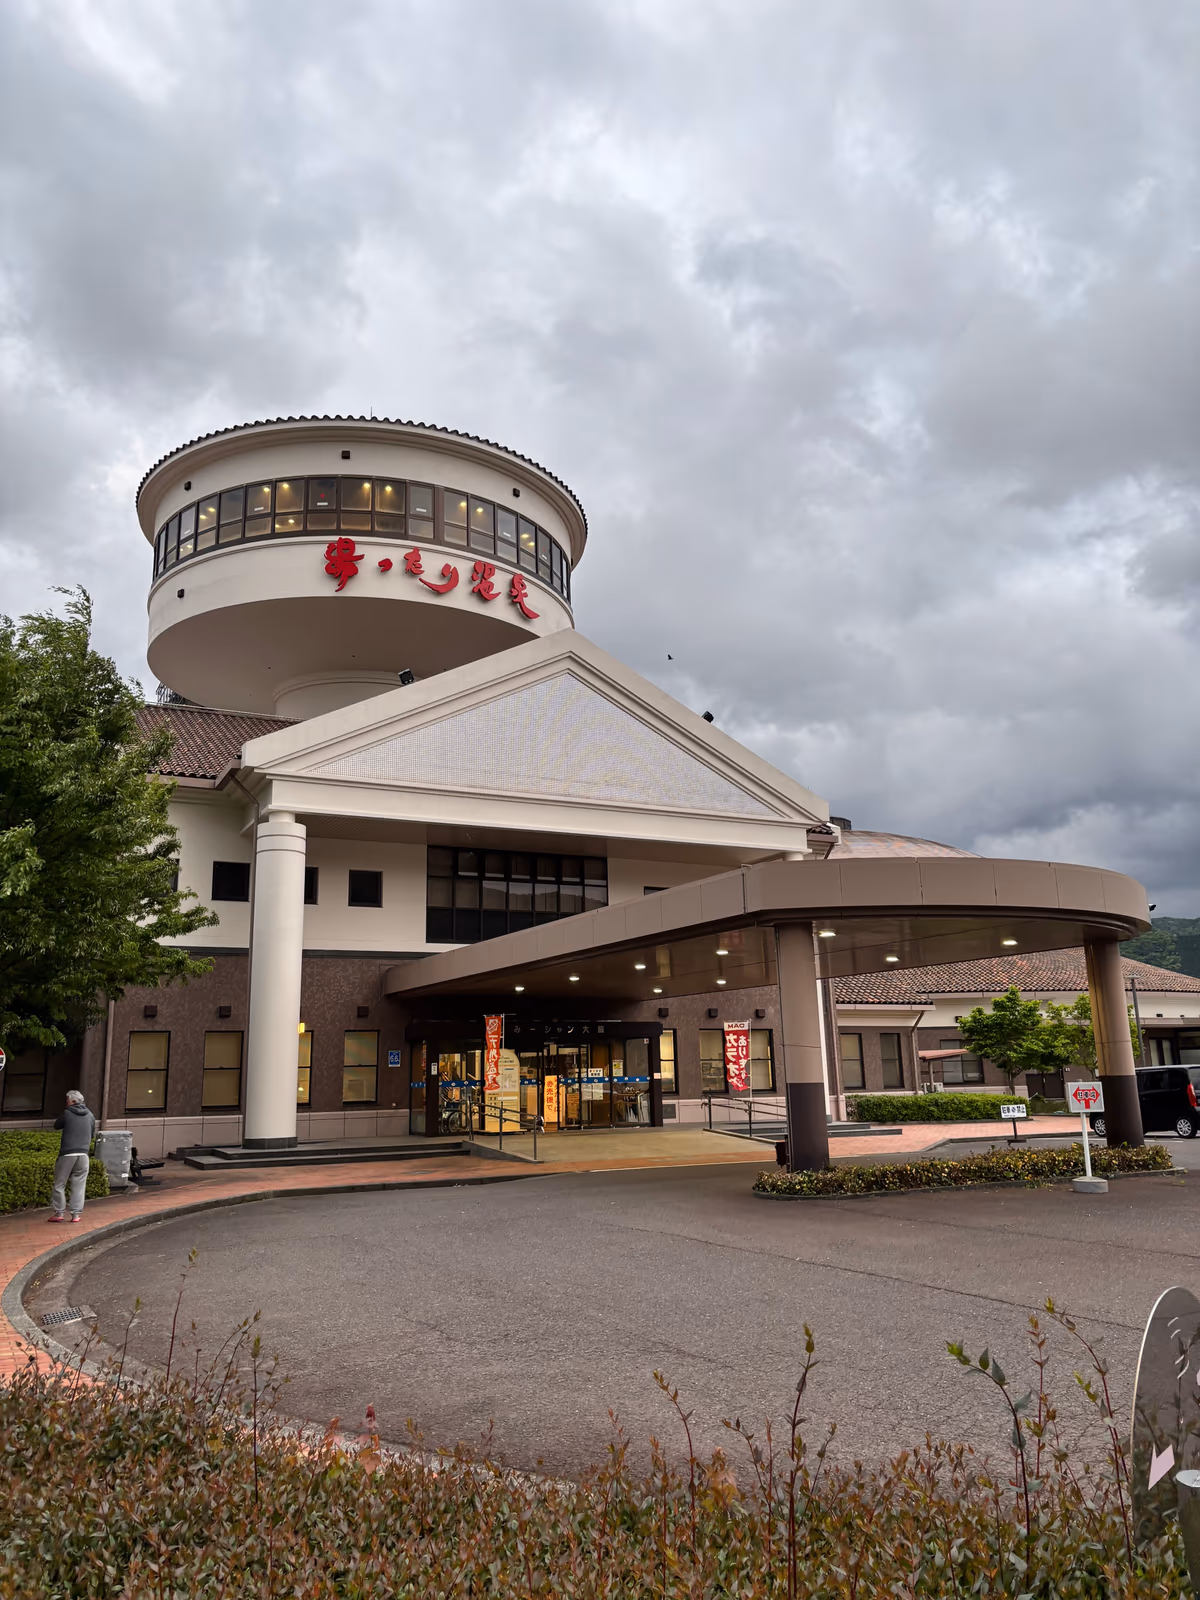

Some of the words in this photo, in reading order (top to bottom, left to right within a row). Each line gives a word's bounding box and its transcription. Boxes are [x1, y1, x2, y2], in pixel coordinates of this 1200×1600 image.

[324, 537, 540, 619] 湯ったり温泉
